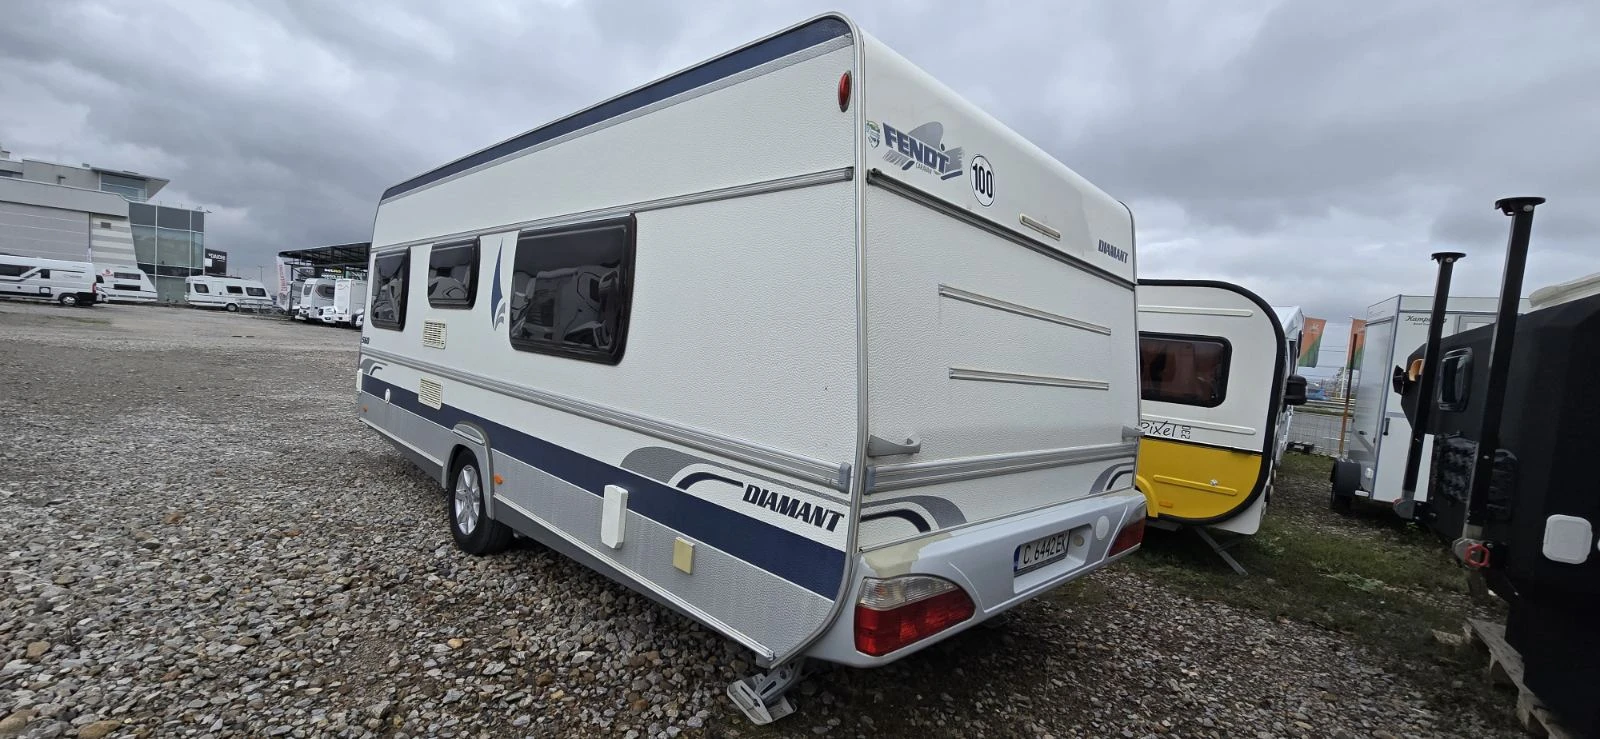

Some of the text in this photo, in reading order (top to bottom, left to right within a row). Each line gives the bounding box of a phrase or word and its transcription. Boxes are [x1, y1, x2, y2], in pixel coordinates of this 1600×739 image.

[883, 122, 950, 174] FENDT
[972, 164, 993, 198] 100
[1098, 239, 1128, 263] DIAMANT
[743, 484, 845, 532] DIAMANT
